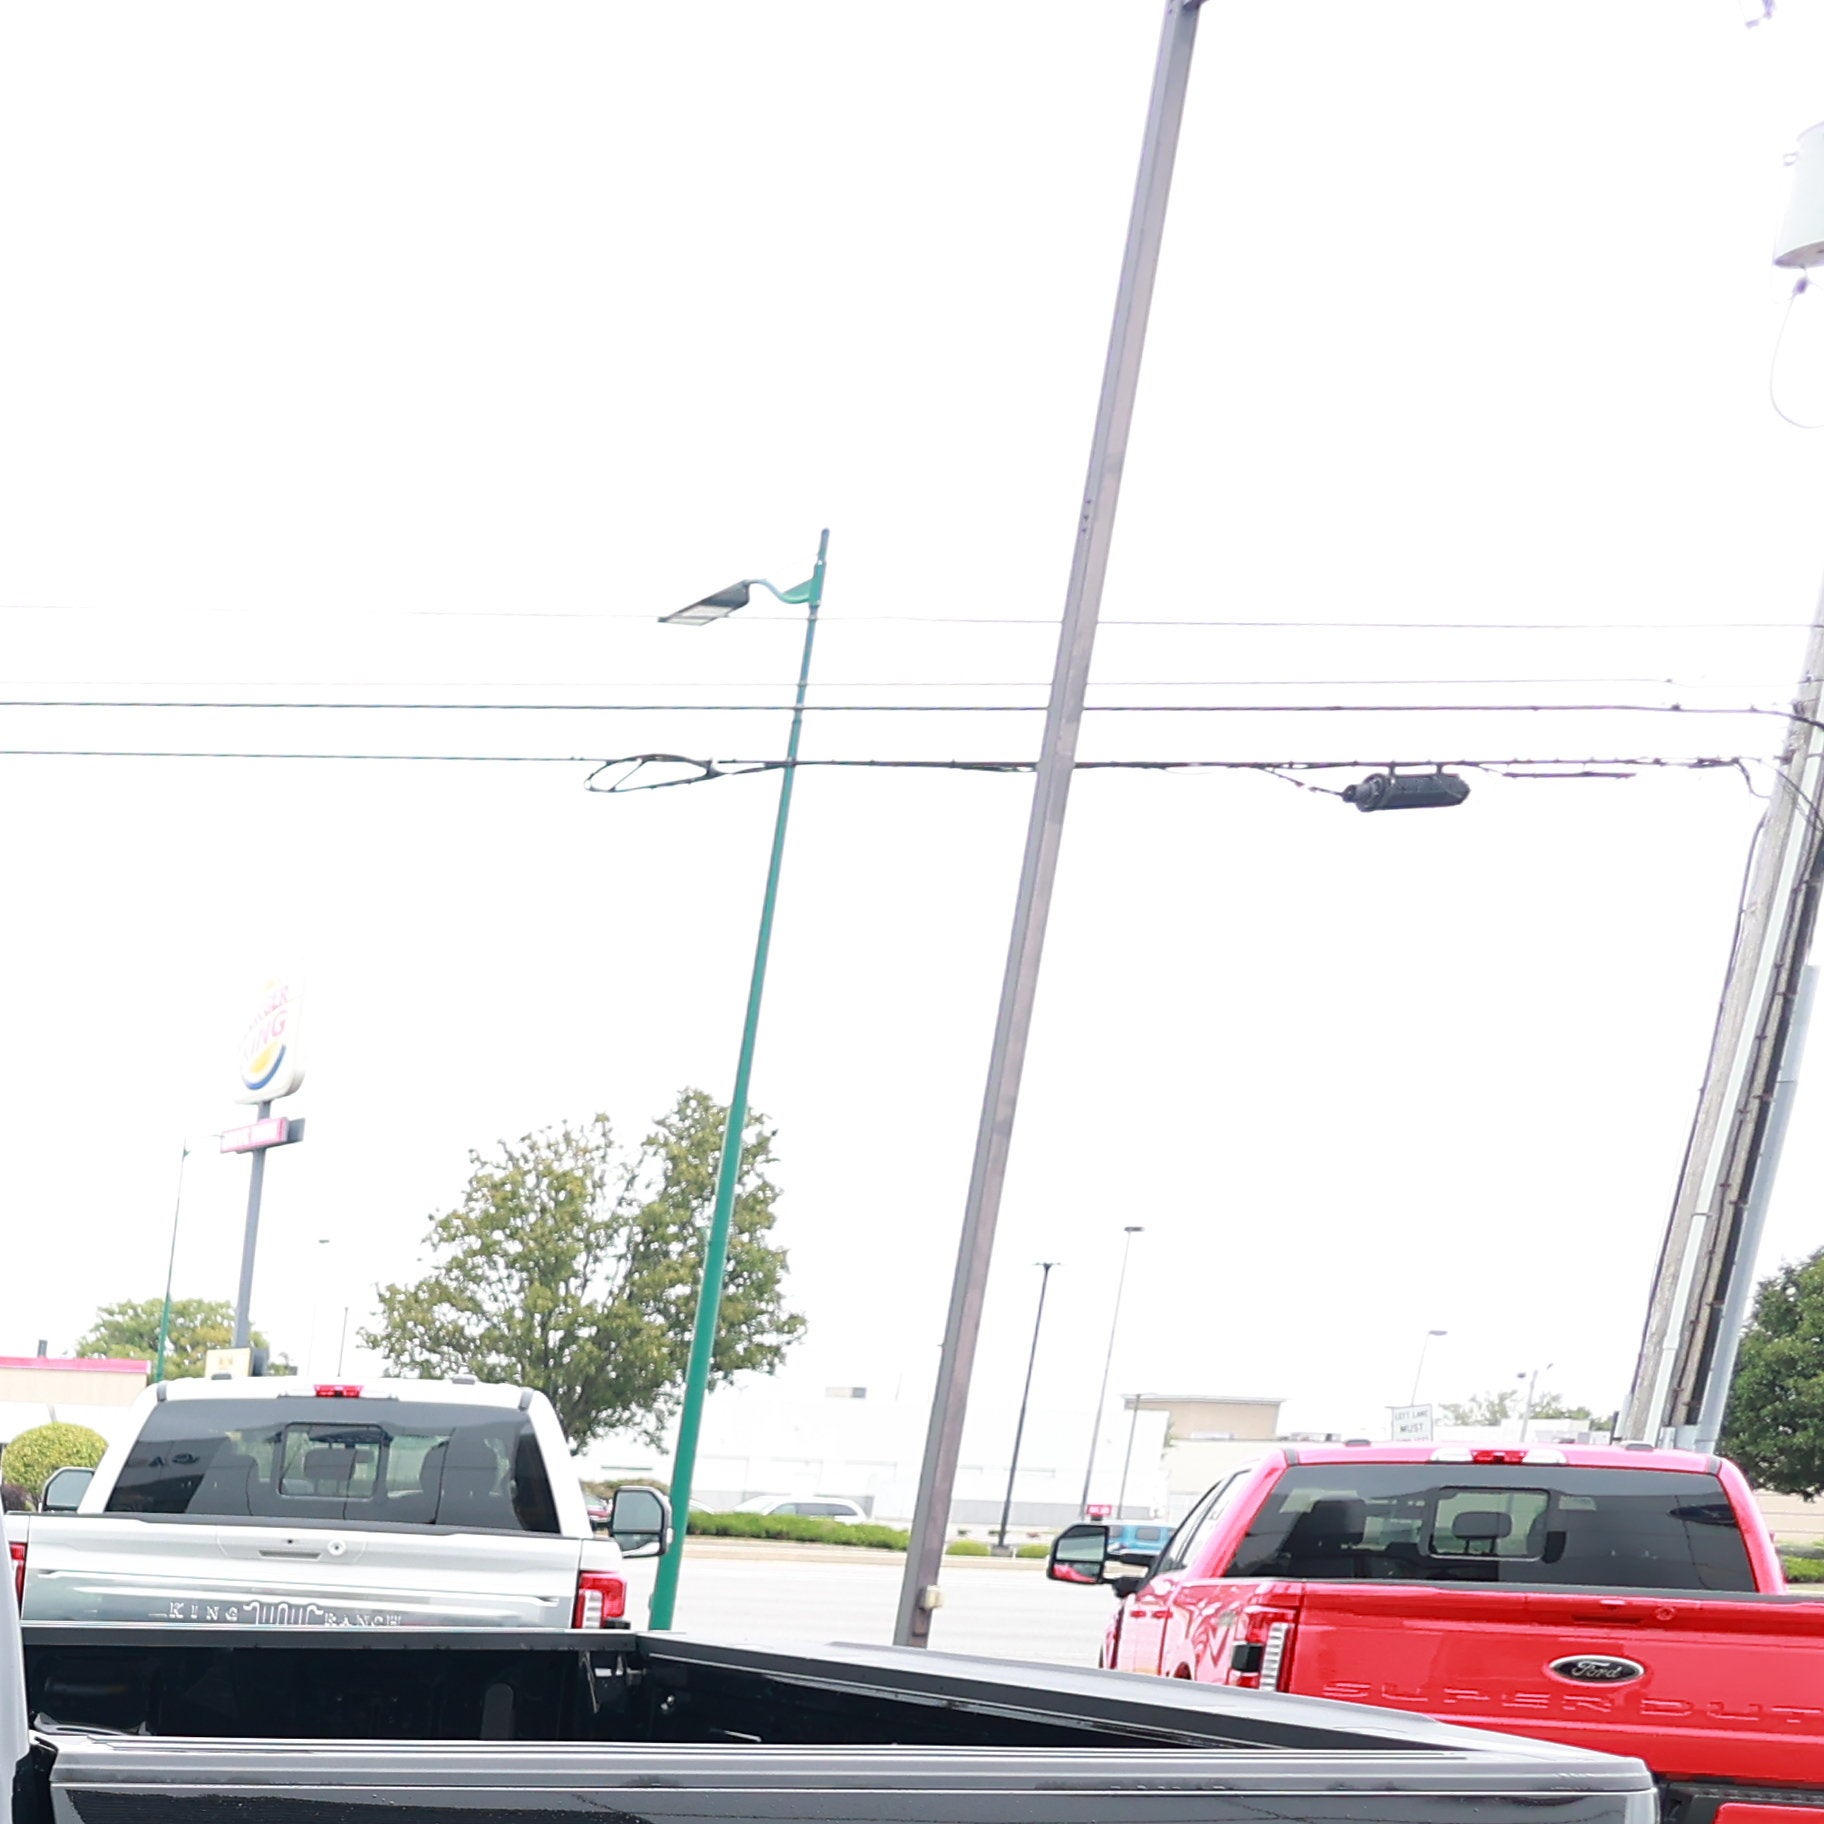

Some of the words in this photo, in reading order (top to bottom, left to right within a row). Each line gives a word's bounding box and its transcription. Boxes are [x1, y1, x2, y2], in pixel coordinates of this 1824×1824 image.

[168, 1602, 239, 1621] KING
[324, 1612, 402, 1627] RANCH
[1571, 1659, 1623, 1680] Ford
[1323, 1681, 1613, 1713] SUPER
